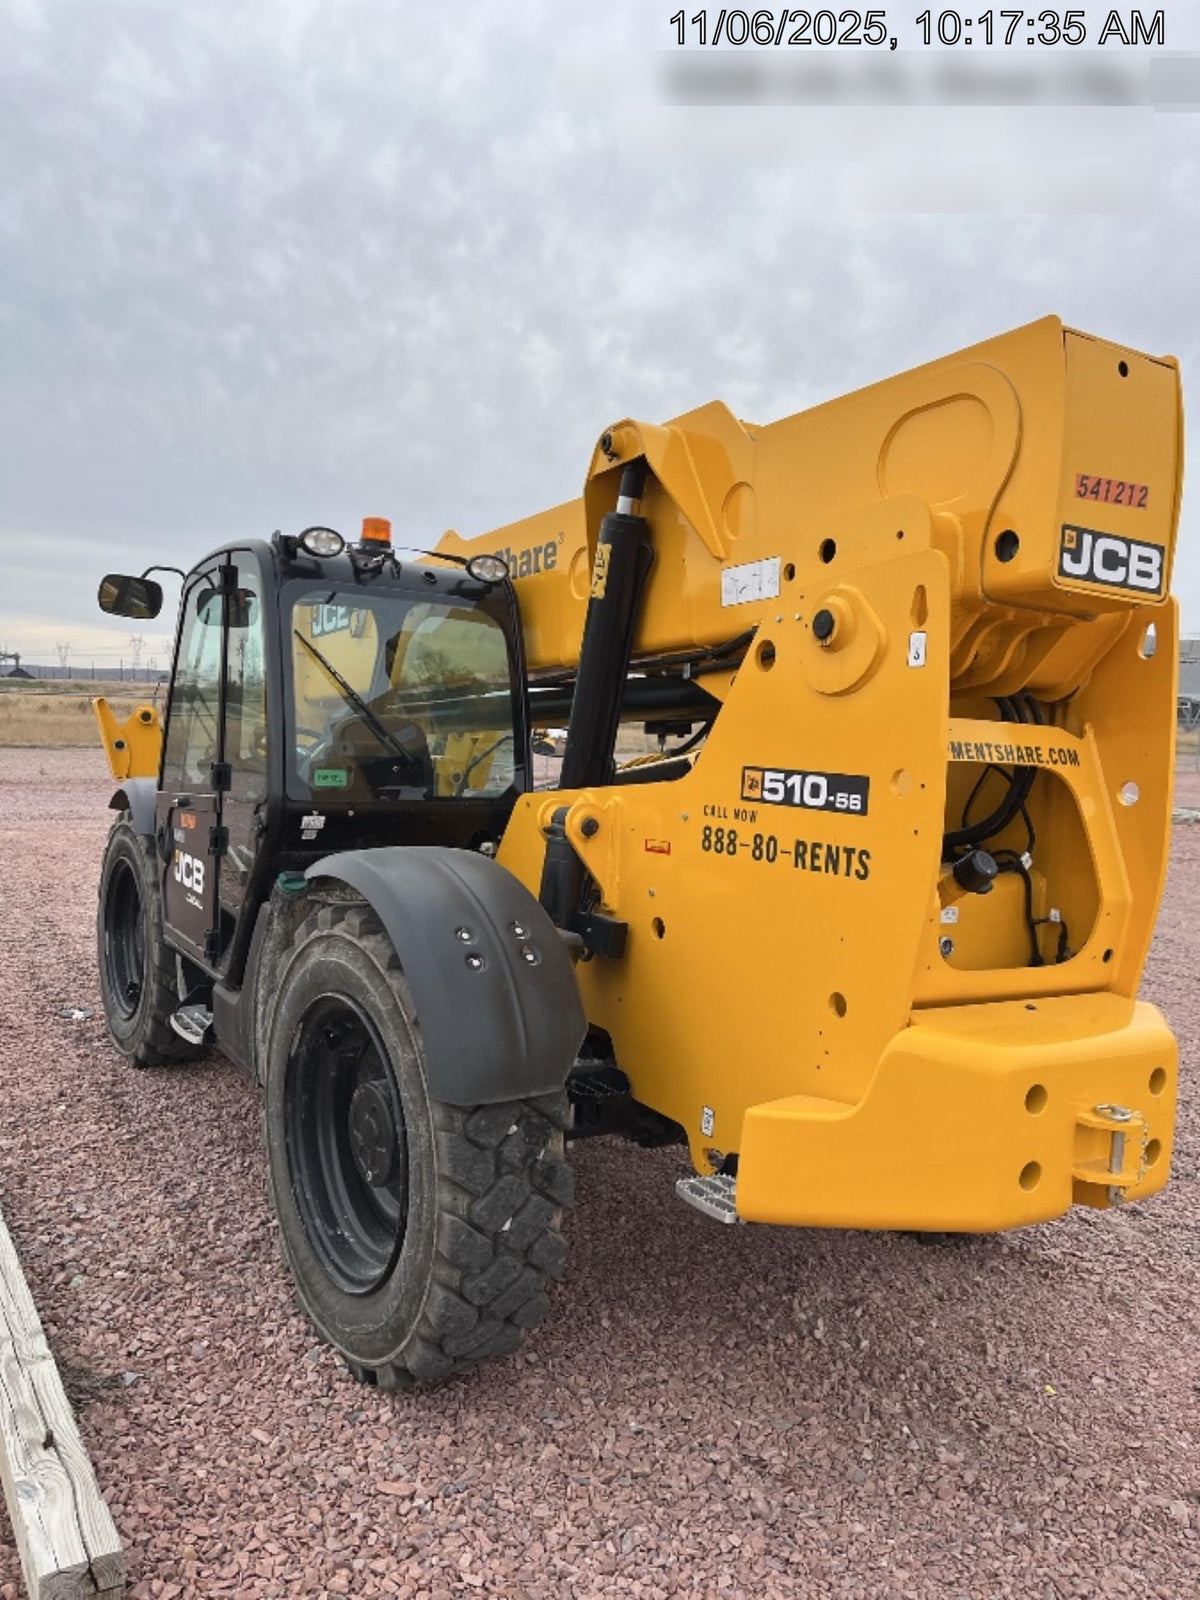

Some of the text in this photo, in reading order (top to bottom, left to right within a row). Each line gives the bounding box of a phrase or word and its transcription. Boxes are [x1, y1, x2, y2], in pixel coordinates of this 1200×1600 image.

[1077, 474, 1149, 508] 541212
[494, 541, 557, 580] hare
[1062, 533, 1162, 589] JCB
[948, 740, 1081, 767] MENTSHARE.COM
[762, 770, 862, 811] 510-56
[703, 804, 758, 823] CALL NOW
[174, 850, 205, 895] JCB
[701, 825, 871, 881] 888-80-RENTS
